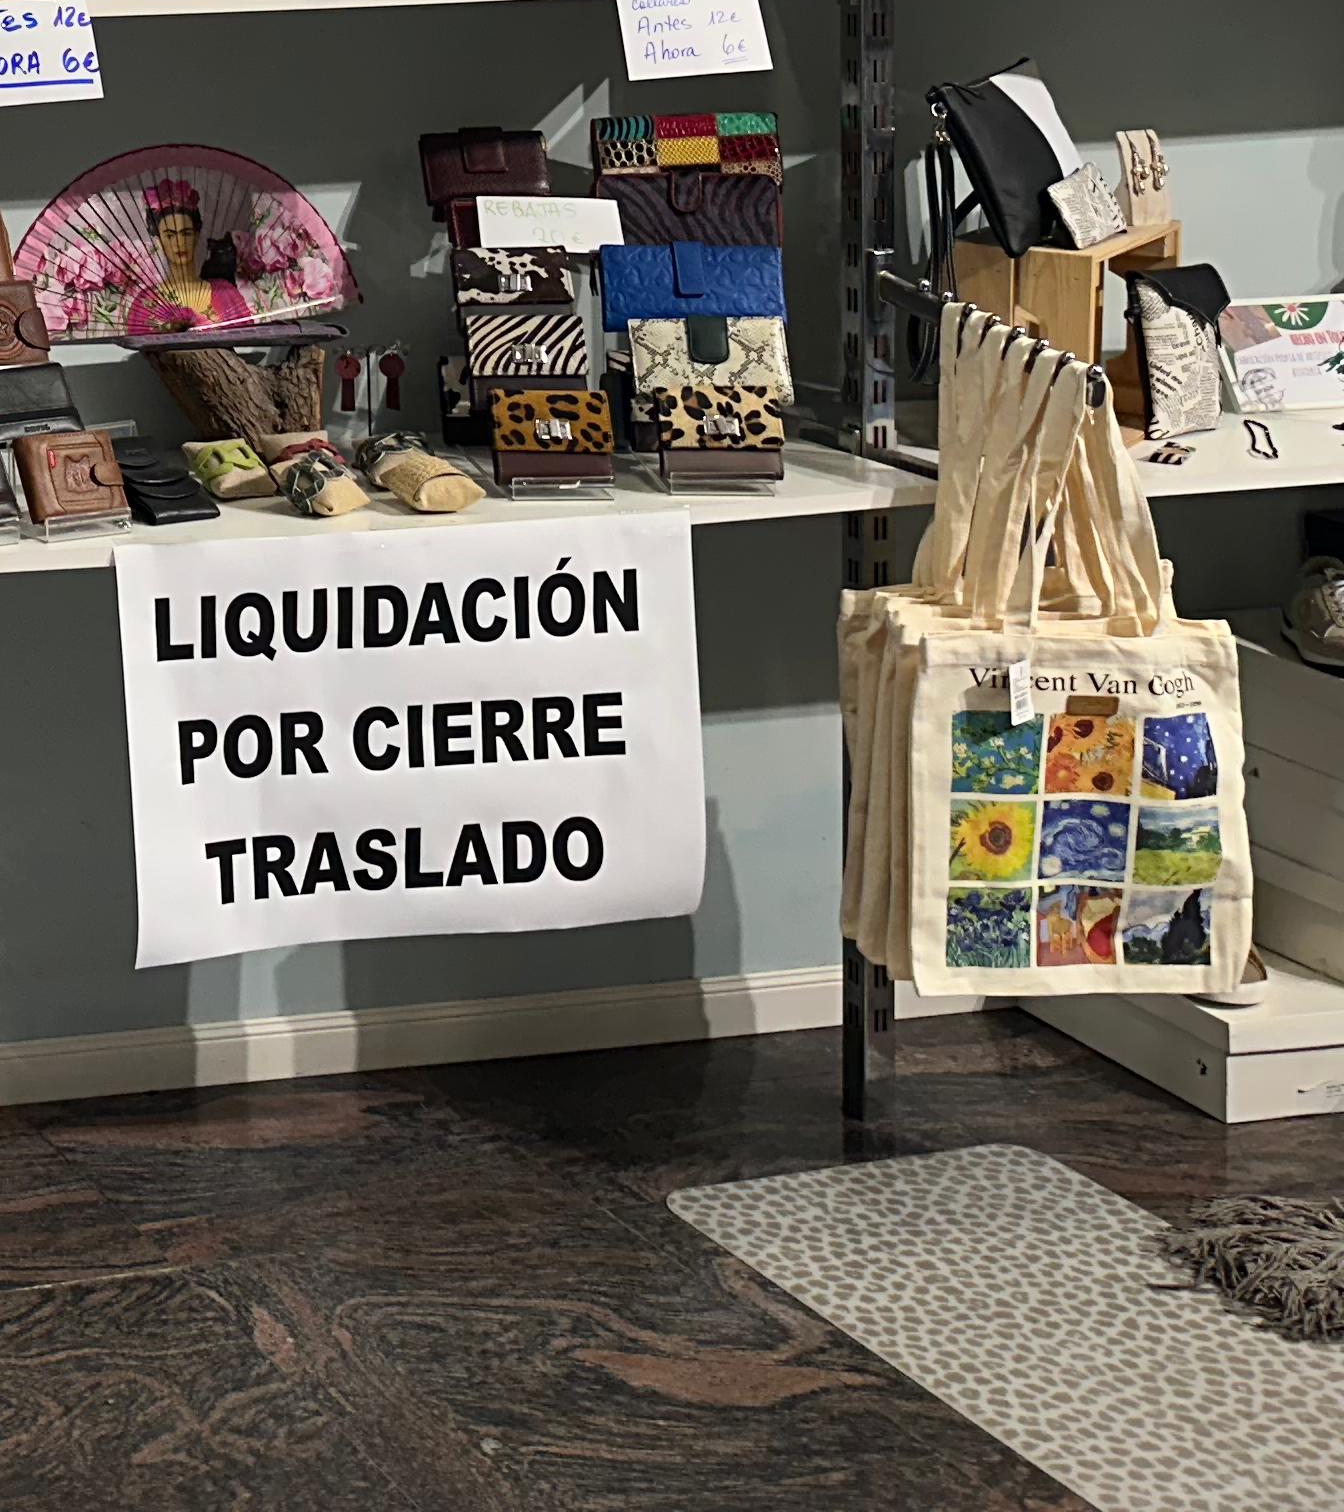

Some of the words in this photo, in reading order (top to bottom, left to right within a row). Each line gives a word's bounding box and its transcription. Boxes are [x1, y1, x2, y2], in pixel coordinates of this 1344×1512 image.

[637, 15, 692, 37] Antes
[644, 39, 701, 64] Ahora
[154, 557, 640, 662] LIQUIDACIÓN
[969, 667, 1077, 692] Vient
[1088, 672, 1137, 694] Van
[178, 711, 328, 786] POR
[353, 692, 626, 772] CIERRE
[205, 816, 604, 904] TRASLADO
